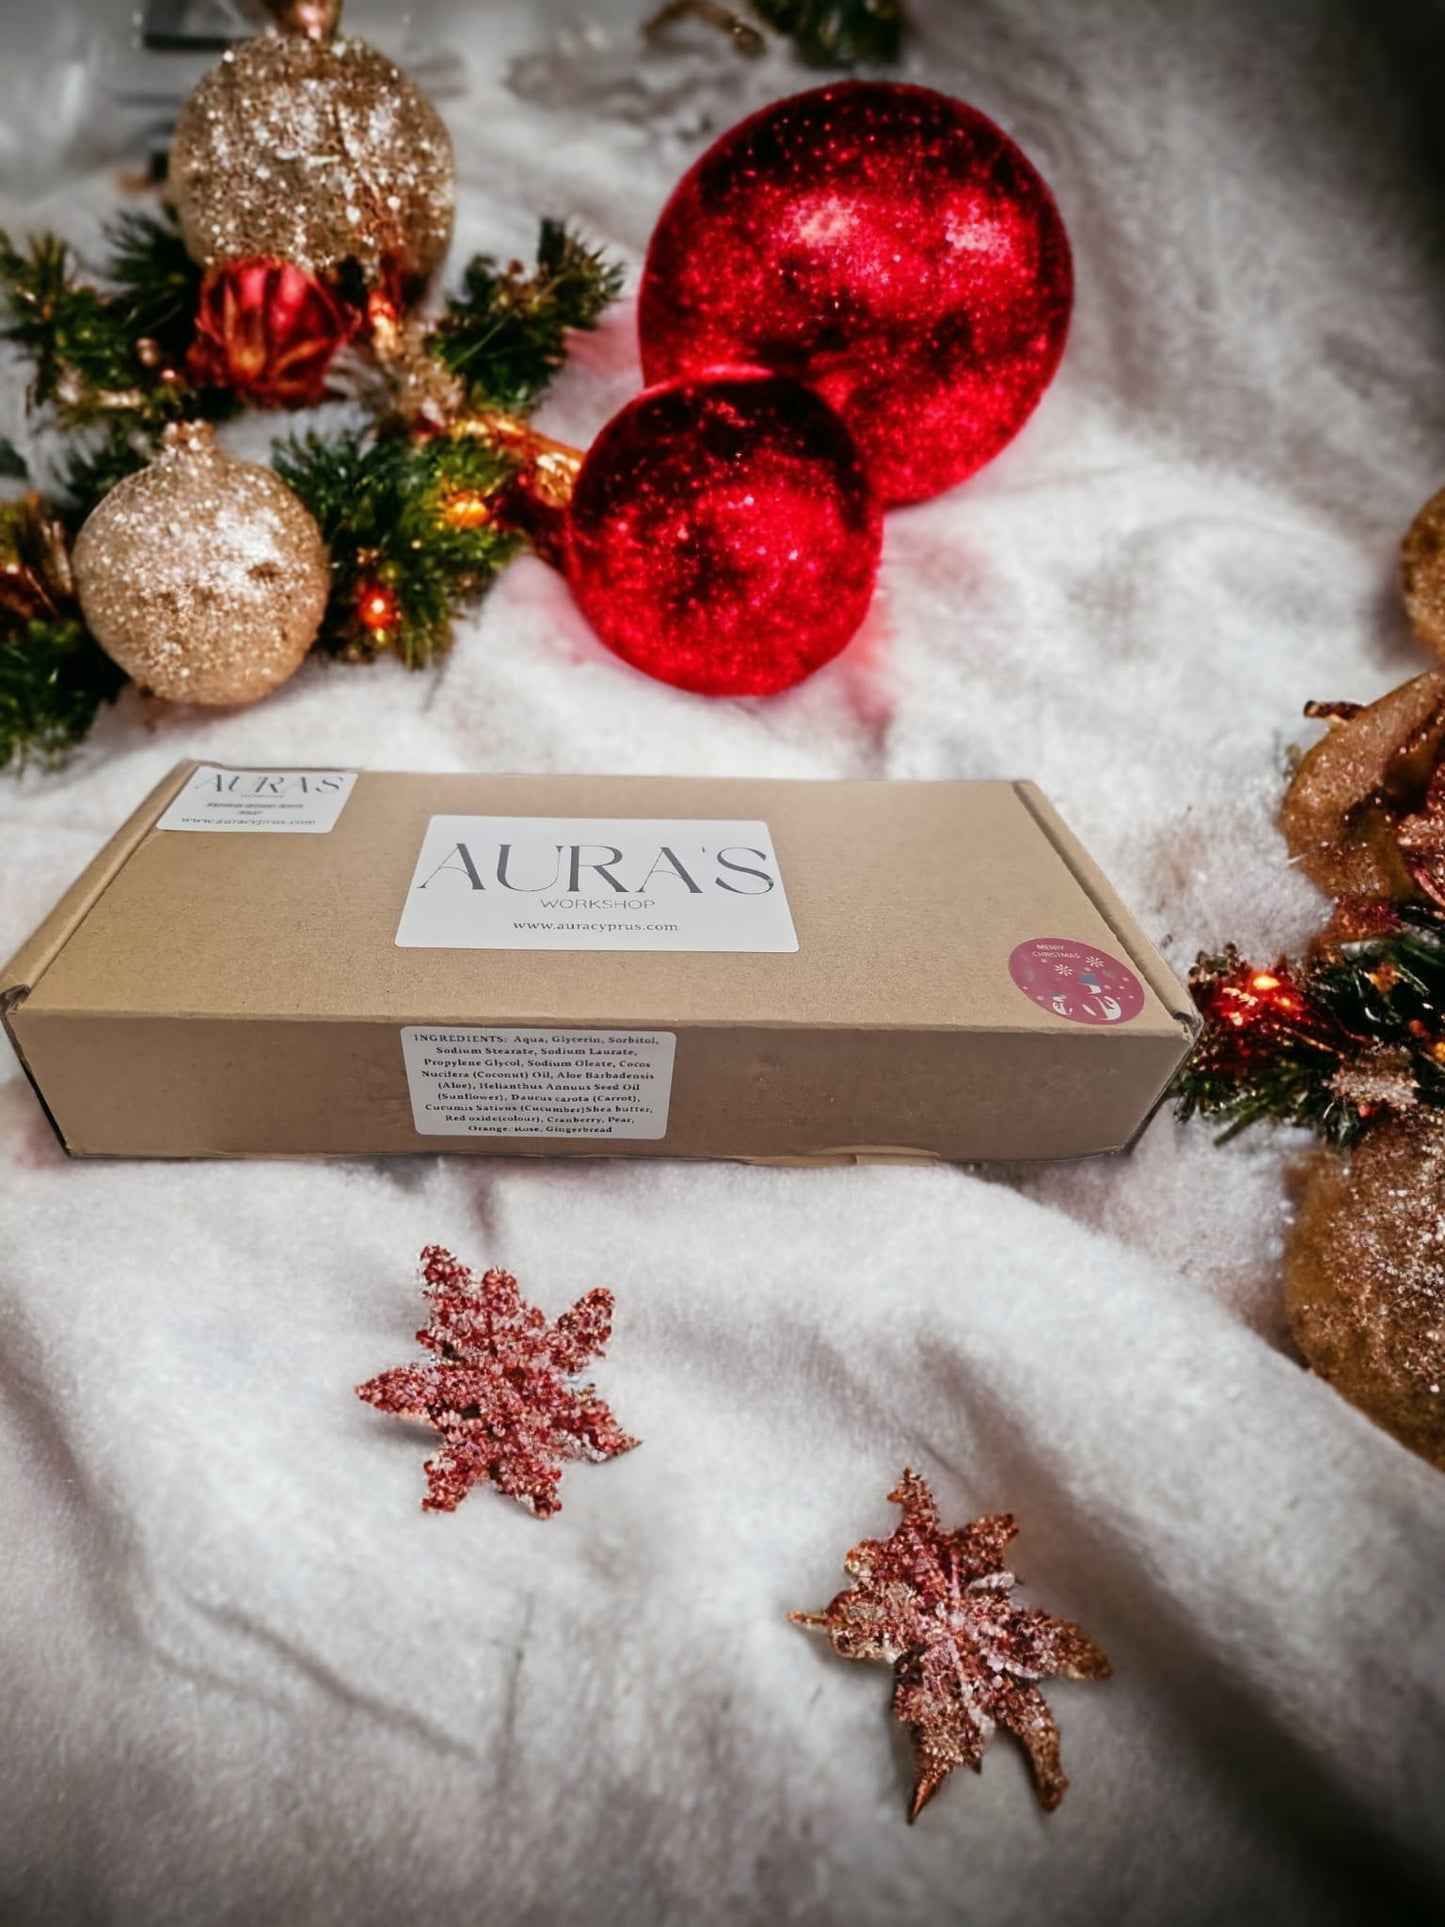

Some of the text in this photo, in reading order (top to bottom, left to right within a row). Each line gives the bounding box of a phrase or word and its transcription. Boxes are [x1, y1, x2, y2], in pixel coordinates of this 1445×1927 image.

[416, 843, 774, 895] AURA'S
[540, 898, 655, 910] WORKSHOP
[513, 920, 678, 932] www.auracyprus.com
[1032, 951, 1080, 959] CHRISTMAS
[414, 1034, 659, 1045] INGREDIENTS: Aqua, Glycerin, Sorbitol,
[485, 1047, 537, 1055] Stearate,
[589, 1048, 637, 1056] Laurate,
[424, 1058, 481, 1067] Propylene
[485, 1059, 524, 1067] Glycol,
[575, 1060, 616, 1068] Oleate,
[619, 1060, 651, 1068] Cocos
[421, 1070, 469, 1078] Nucifera
[473, 1071, 529, 1079] (Coconut)
[532, 1071, 554, 1079] Oil,
[585, 1072, 655, 1080] Barbadensis
[438, 1082, 476, 1090] (Aloe),
[546, 1083, 591, 1091] Annuus
[438, 1093, 508, 1102] (Sunflower),
[593, 1095, 641, 1103] (Carrot),
[615, 1105, 653, 1114] butter,
[547, 1116, 605, 1124] Cranberry,
[608, 1116, 634, 1124] Pear,
[546, 1126, 613, 1134] Gingerbread
